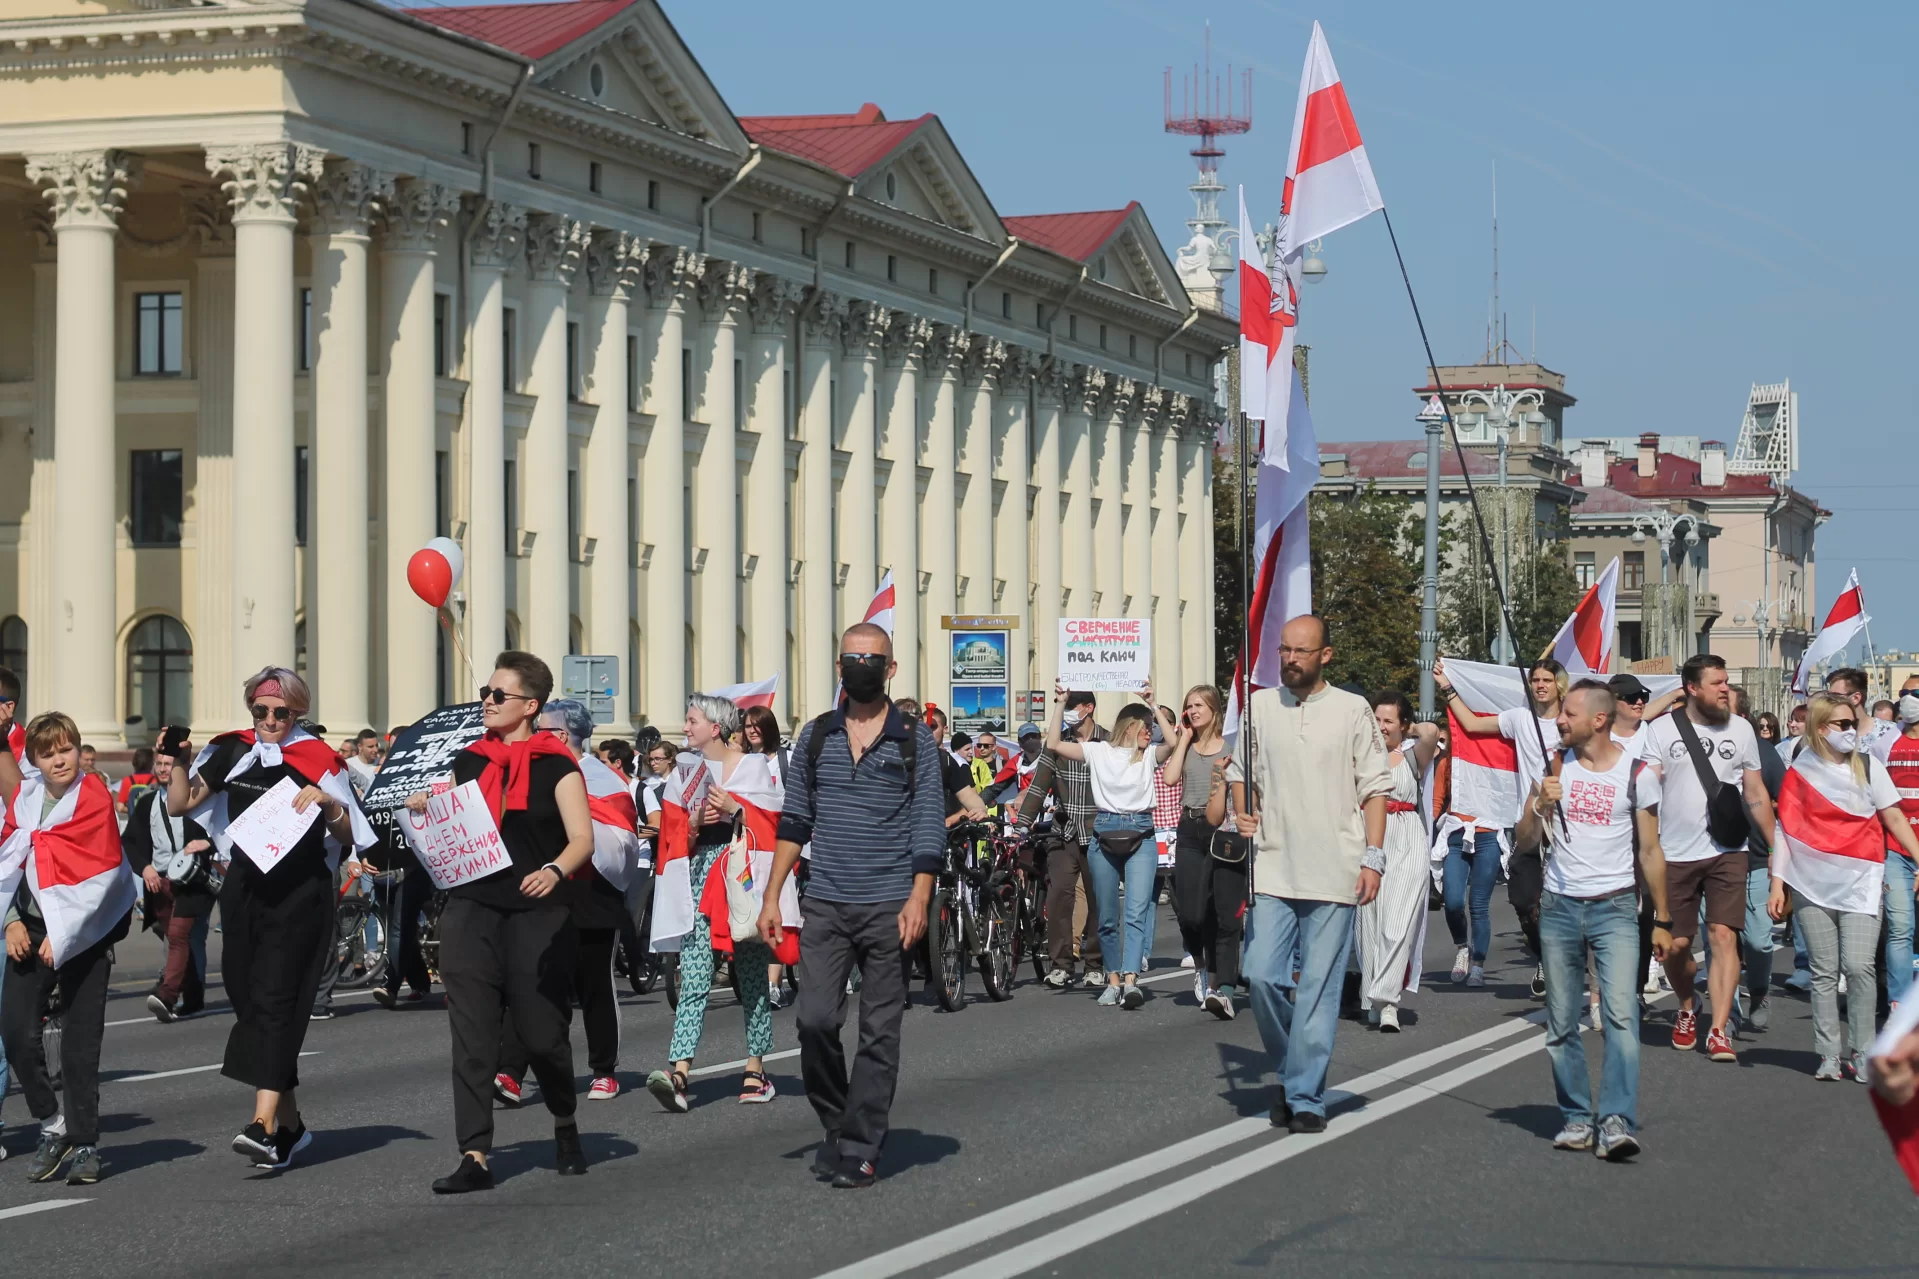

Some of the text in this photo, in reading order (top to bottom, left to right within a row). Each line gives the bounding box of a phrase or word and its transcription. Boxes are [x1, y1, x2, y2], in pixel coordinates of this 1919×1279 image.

[1067, 650, 1136, 663] ПОД КЛЮЧ
[1636, 658, 1664, 674] HAPPY
[381, 757, 456, 775] ПРОСТ
